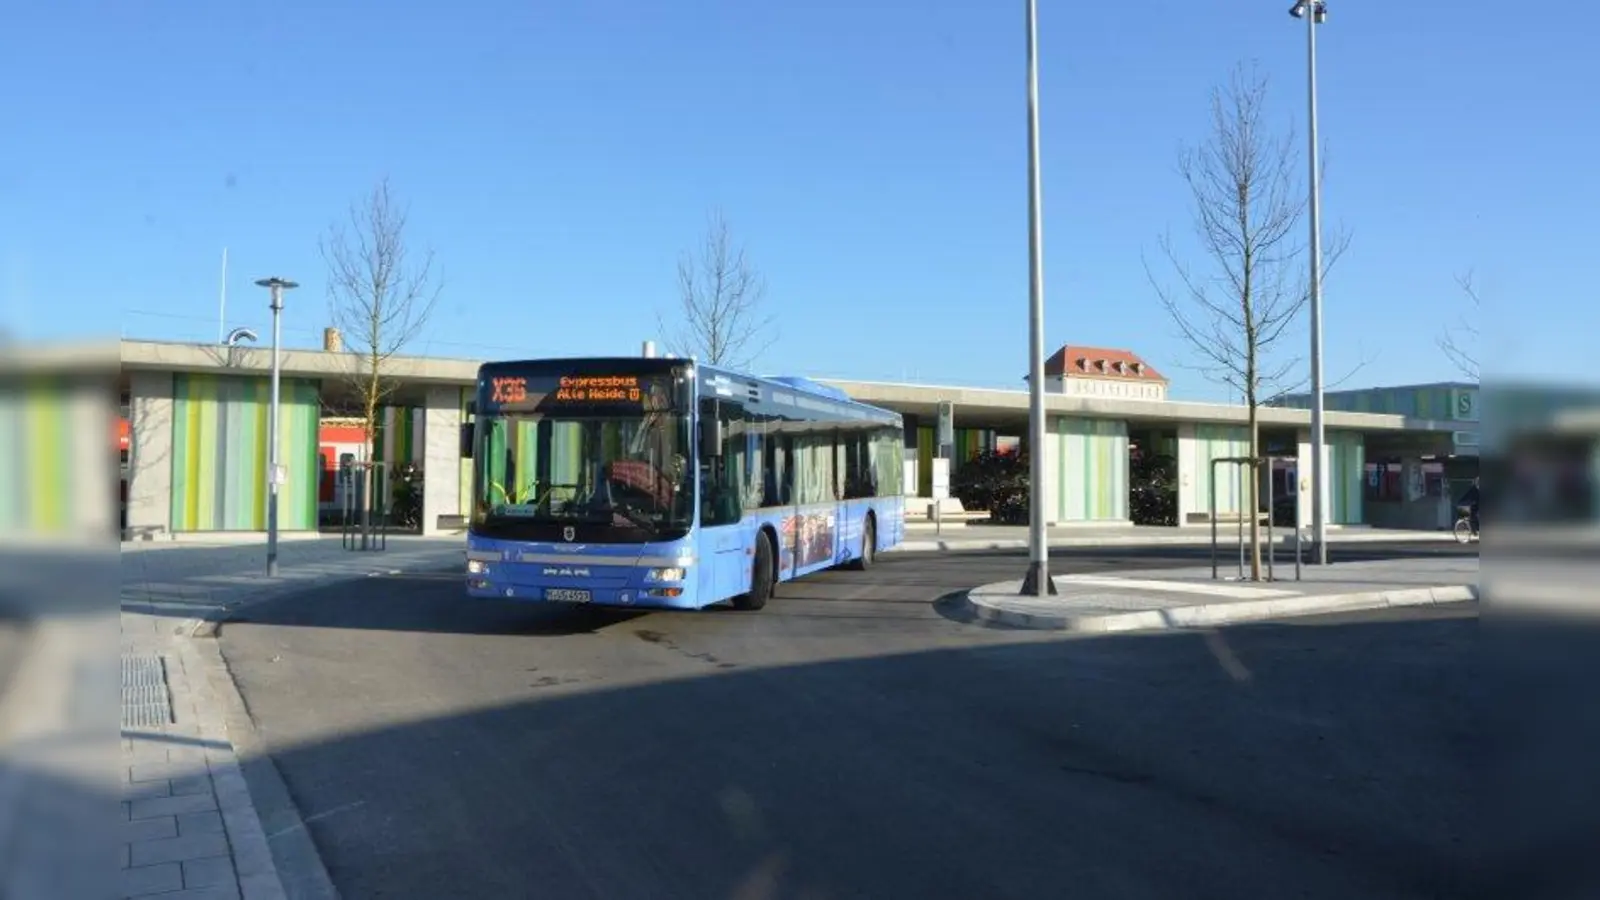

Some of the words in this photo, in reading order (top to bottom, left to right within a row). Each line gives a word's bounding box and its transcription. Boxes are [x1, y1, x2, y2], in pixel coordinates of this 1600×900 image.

[559, 376, 637, 387] Expressbus
[588, 388, 626, 400] Heide
[1460, 395, 1470, 412] S
